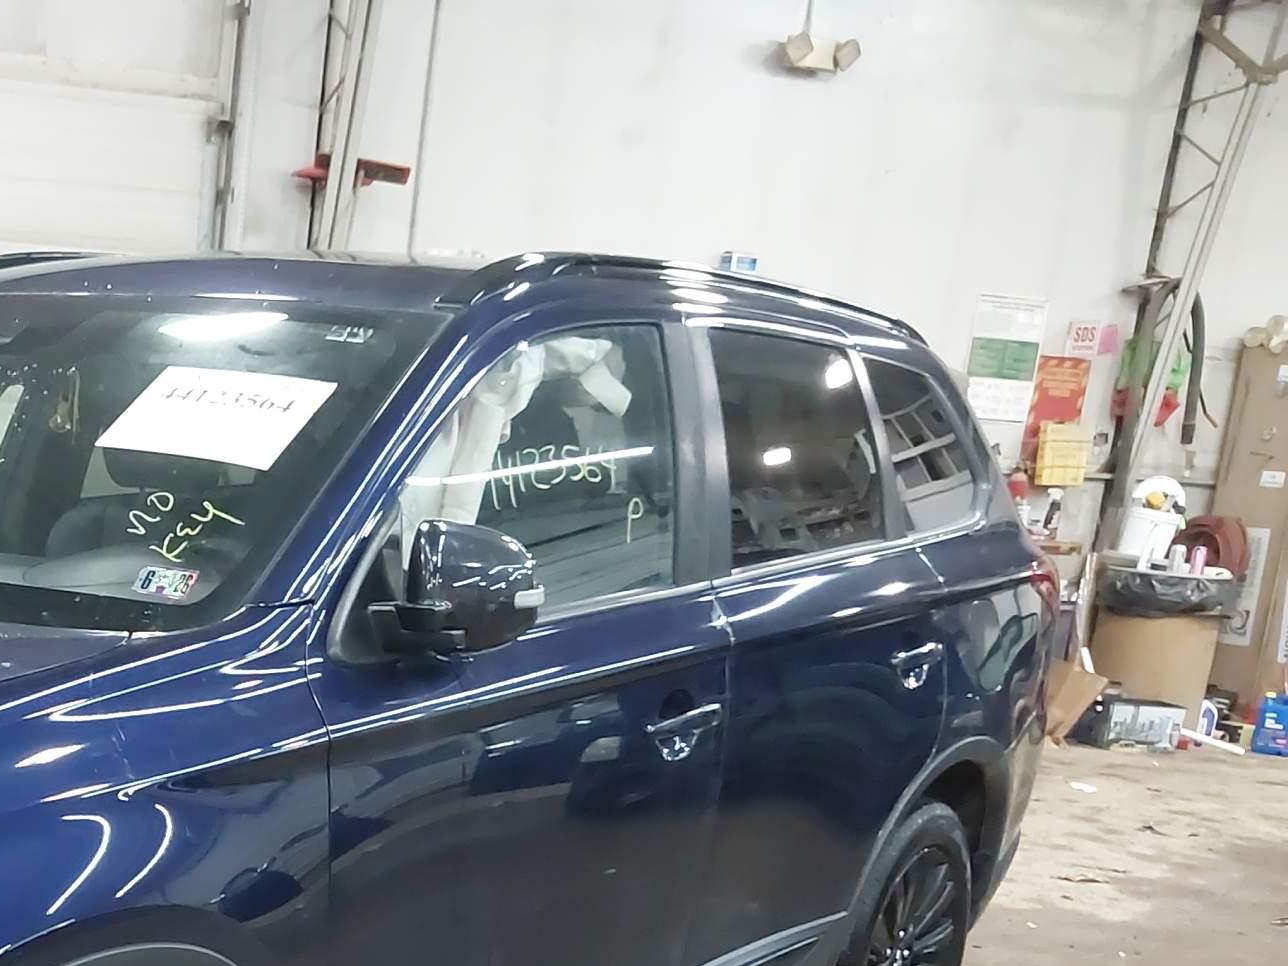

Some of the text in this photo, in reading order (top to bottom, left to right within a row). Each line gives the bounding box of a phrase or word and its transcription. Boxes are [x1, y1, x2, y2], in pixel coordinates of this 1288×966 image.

[1073, 326, 1097, 342] SDS
[626, 497, 644, 544] P
[140, 570, 156, 590] 6
